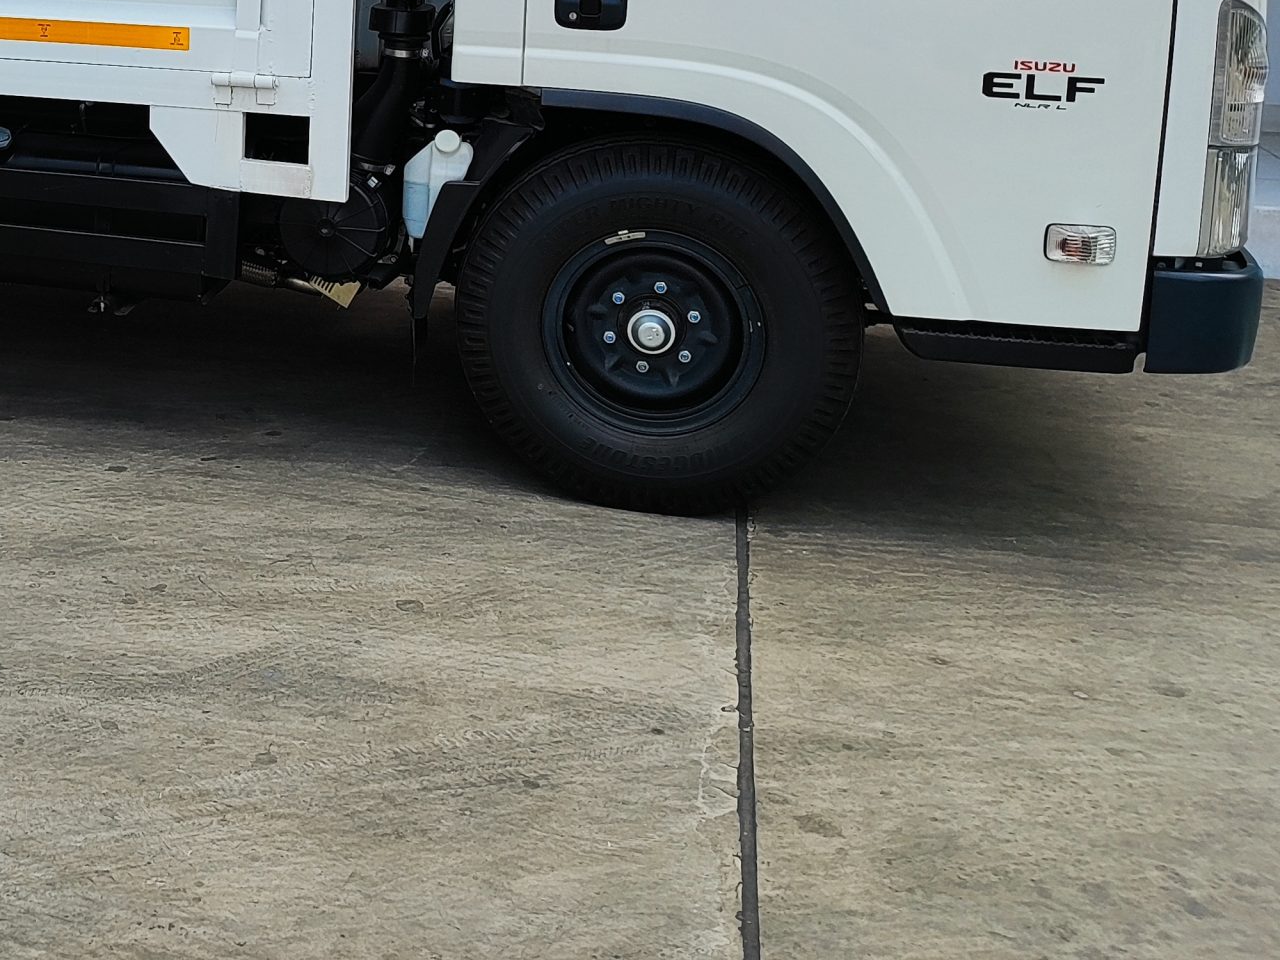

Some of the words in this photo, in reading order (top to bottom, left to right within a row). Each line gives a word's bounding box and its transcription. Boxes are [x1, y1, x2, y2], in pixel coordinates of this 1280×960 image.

[1014, 60, 1076, 73] ISUZU
[982, 71, 1106, 102] ELF
[1014, 102, 1051, 110] NLR
